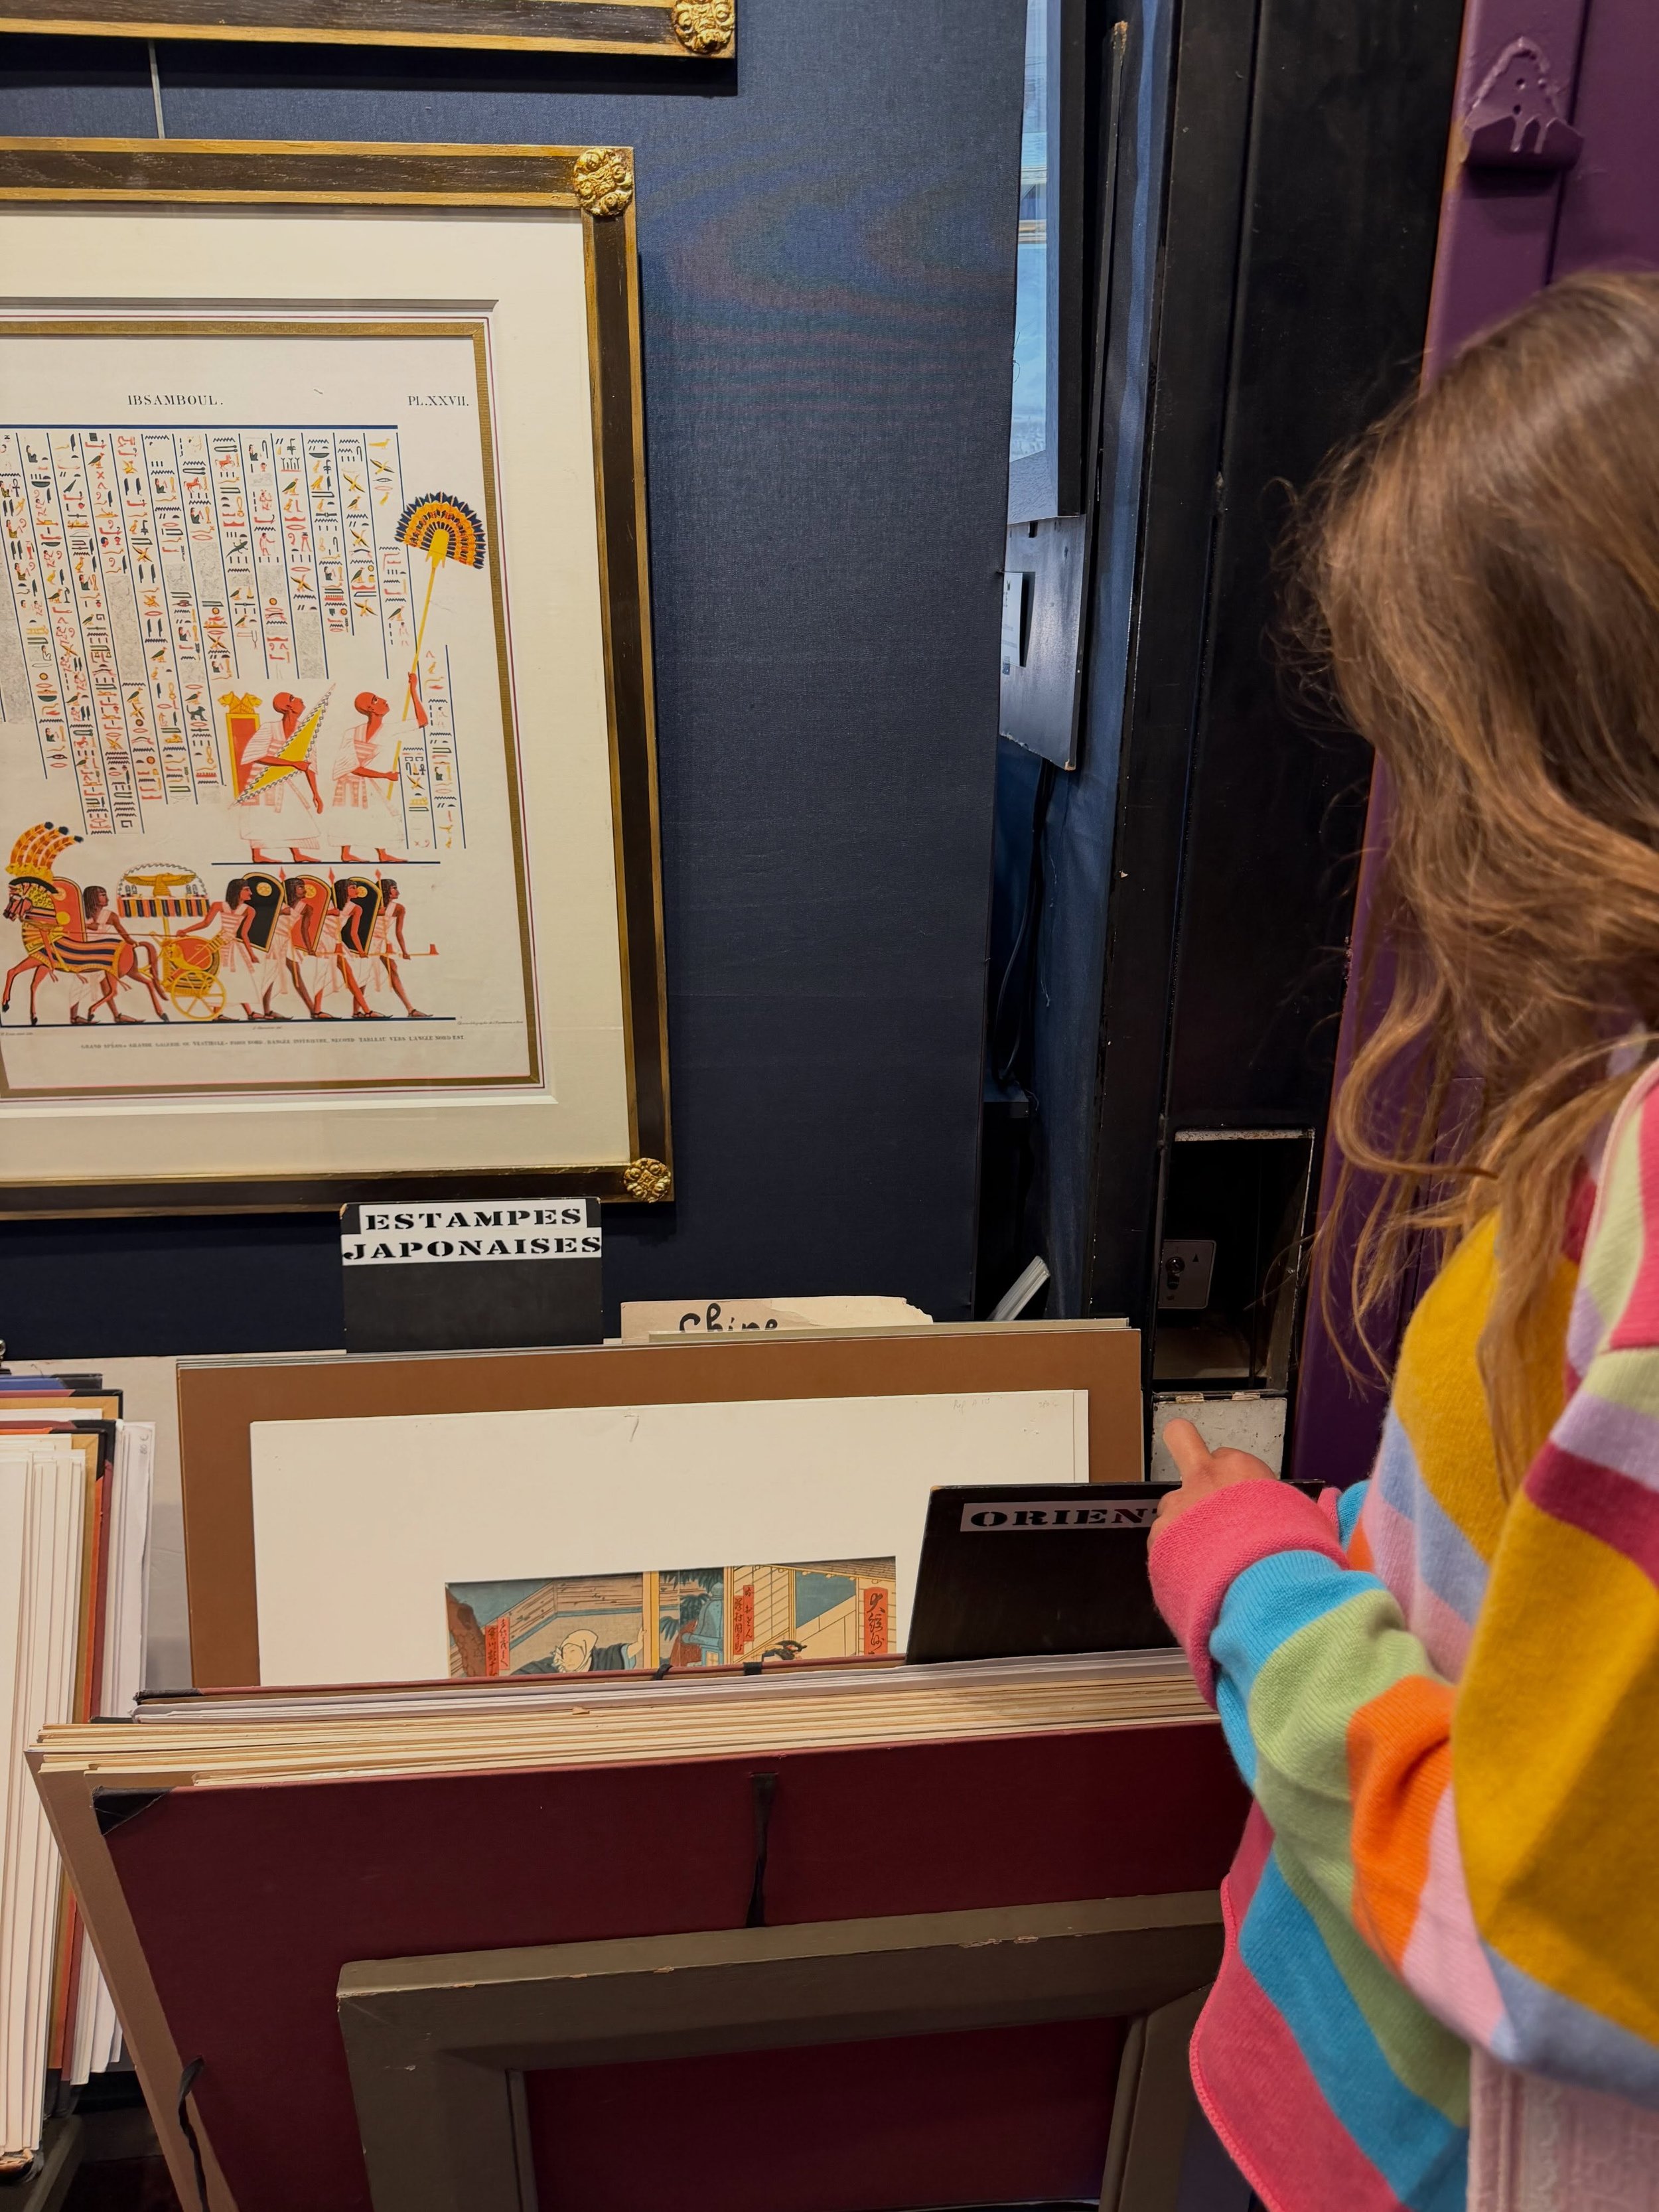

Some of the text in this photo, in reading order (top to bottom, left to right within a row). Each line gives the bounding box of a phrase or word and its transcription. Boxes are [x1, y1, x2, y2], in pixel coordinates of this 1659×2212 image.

[127, 395, 224, 406] IBSAMBOUL.
[366, 1209, 581, 1230] ESTAMPES
[343, 1236, 601, 1260] JAPONAISES
[970, 1508, 1157, 1527] ORIEN
